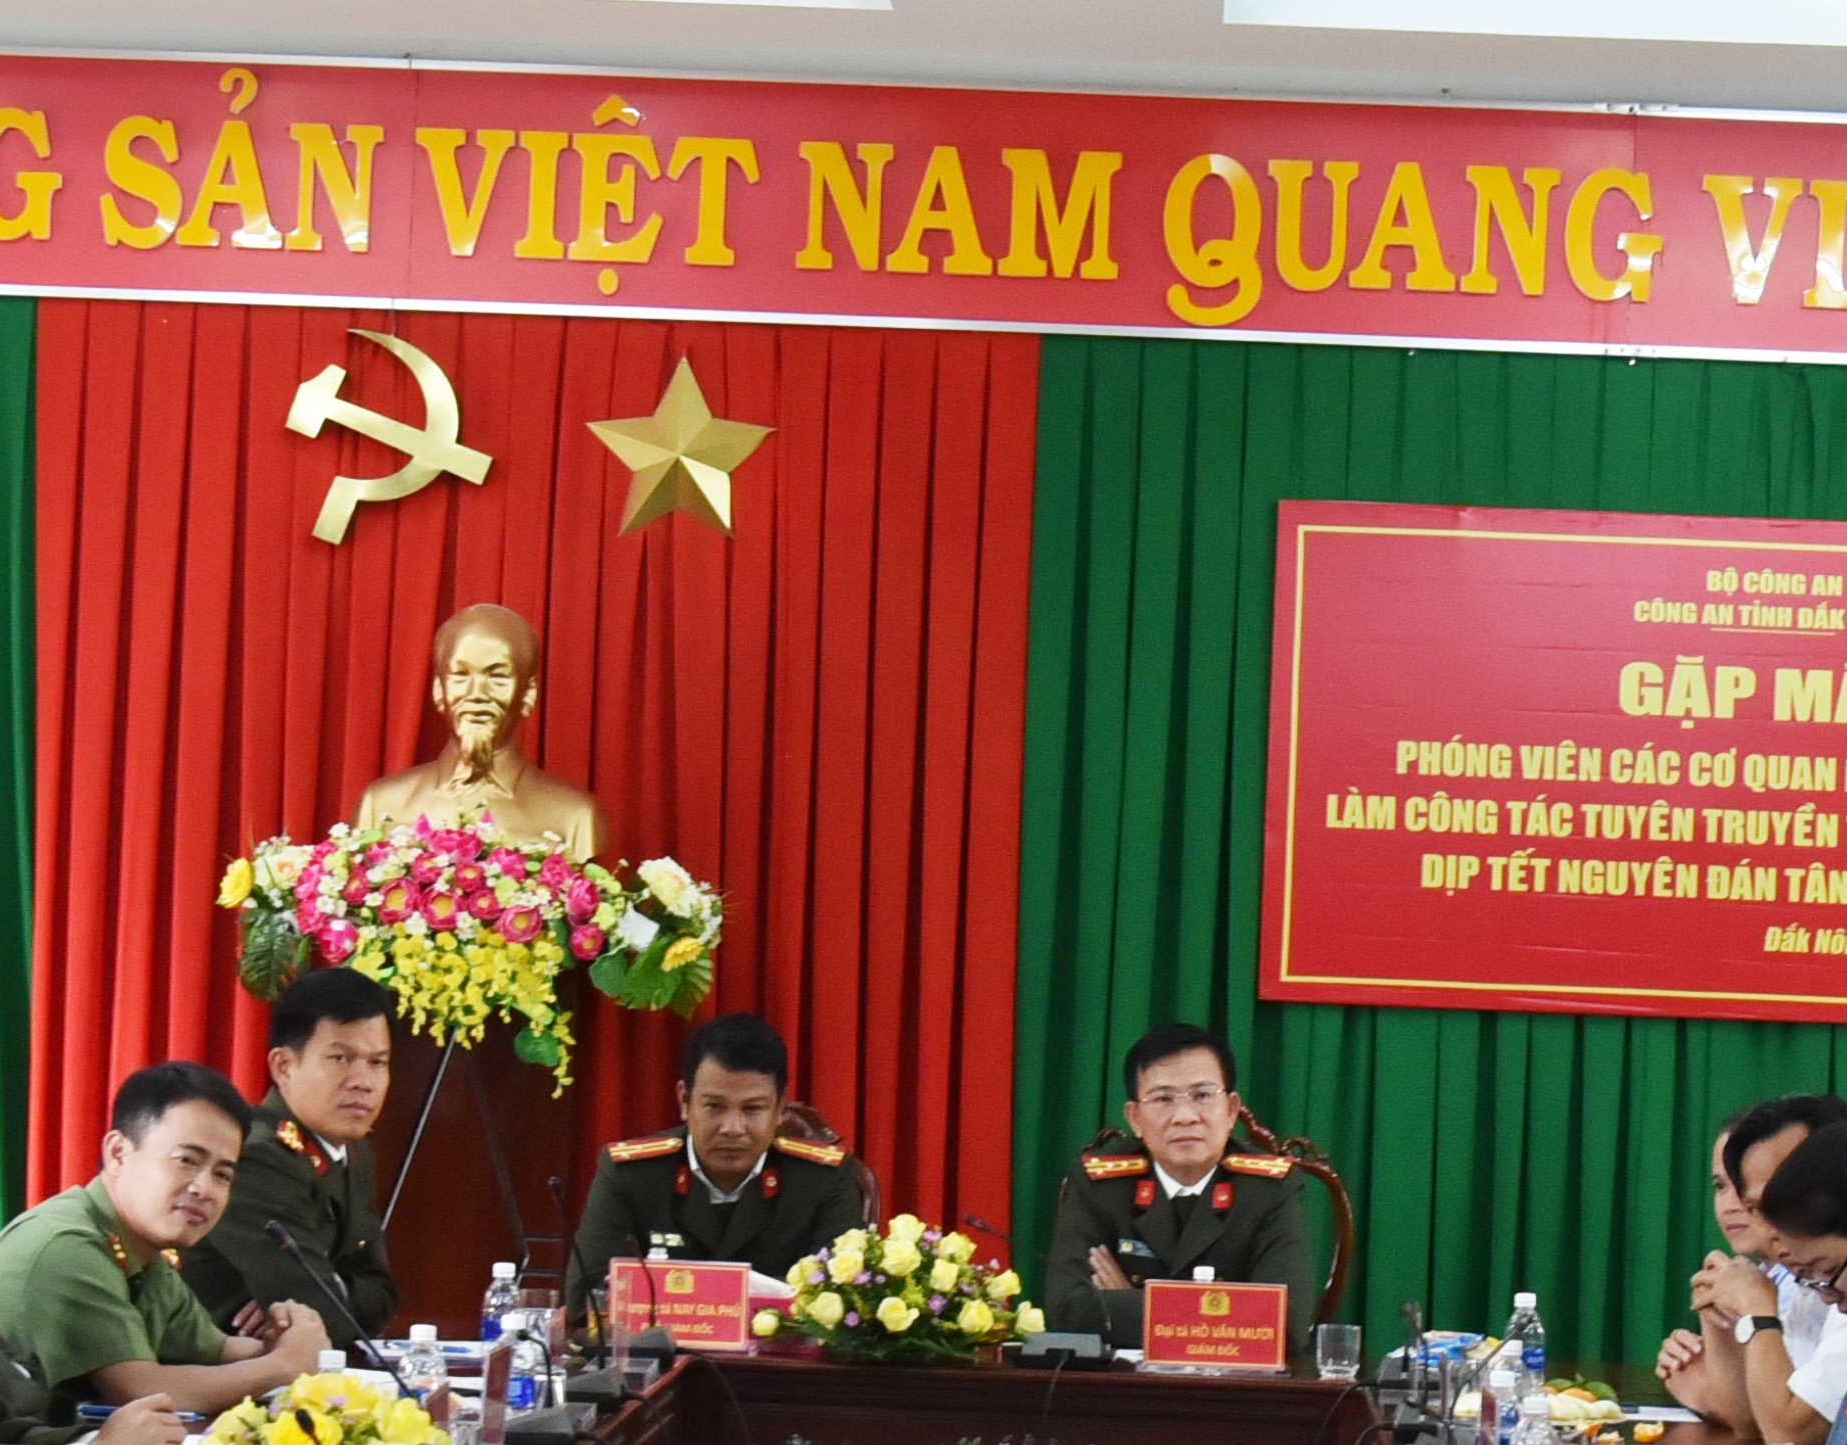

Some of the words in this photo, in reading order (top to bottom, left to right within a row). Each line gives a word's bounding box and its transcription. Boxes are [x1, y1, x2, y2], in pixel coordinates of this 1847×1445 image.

[99, 69, 385, 254] SẢN
[414, 96, 761, 296] VIỆT
[794, 140, 1123, 280] NAM
[1162, 153, 1666, 327] QUANG
[1705, 566, 1739, 597] BỘ
[1743, 568, 1807, 596] CÔNG
[1811, 574, 1844, 597] AN
[1633, 596, 1698, 624] CÔNG
[1701, 603, 1734, 626] AN
[1738, 599, 1793, 628] TỈNH
[1797, 601, 1846, 631] ĐẮK
[1618, 654, 1757, 730] GẶP
[1396, 733, 1513, 780] PHÓNG
[1519, 738, 1603, 783] VIÊN
[1609, 741, 1682, 787] CÁC
[1688, 746, 1738, 789] CƠ
[1743, 753, 1838, 793] QUAN
[1326, 786, 1397, 831] LÀM
[1404, 790, 1499, 835] CÔNG
[1506, 793, 1574, 838] TÁC
[1581, 798, 1695, 843] TUYÊN
[1702, 801, 1840, 849] TRUYỀN
[1420, 853, 1481, 897] DỊP
[1487, 847, 1552, 893] TẾT
[1557, 855, 1699, 899] NGUYÊN
[1705, 858, 1778, 902] ĐÁN
[1763, 923, 1811, 954] Đắk
